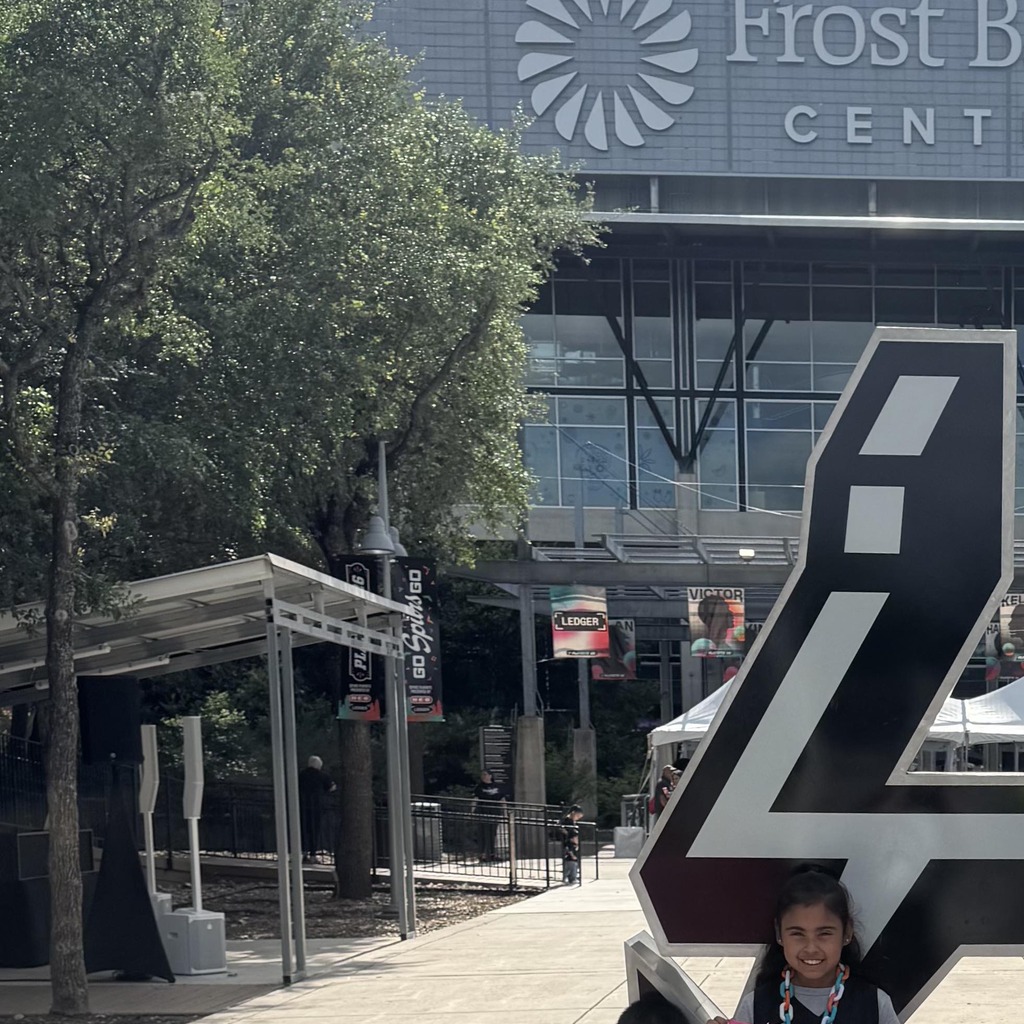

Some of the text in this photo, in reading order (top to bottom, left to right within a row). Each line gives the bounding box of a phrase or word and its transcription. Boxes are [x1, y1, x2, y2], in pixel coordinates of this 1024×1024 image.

[727, 0, 946, 68] Frost
[409, 569, 422, 593] GO
[689, 588, 743, 602] VICTOR
[561, 617, 599, 626] LEDGER
[412, 655, 426, 679] GO
